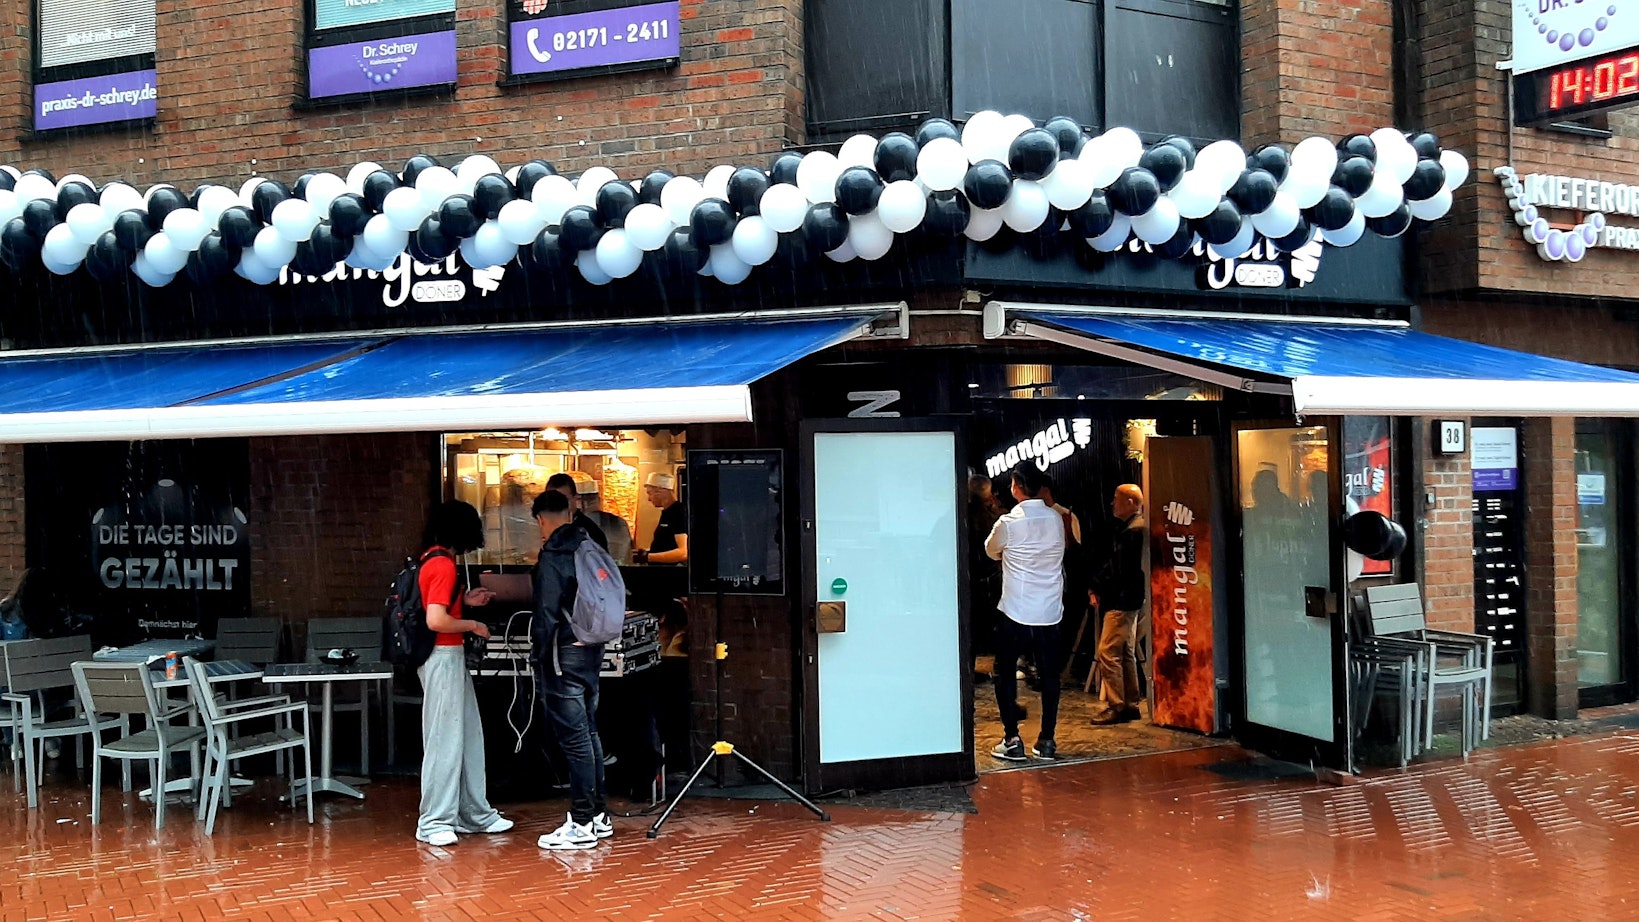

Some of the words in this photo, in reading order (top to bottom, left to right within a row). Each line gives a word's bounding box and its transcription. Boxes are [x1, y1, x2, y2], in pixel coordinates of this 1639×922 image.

[362, 45, 378, 58] Dr.
[379, 42, 418, 56] Schrey
[553, 27, 607, 51] 02171
[627, 19, 669, 43] 2411
[41, 82, 157, 116] praxis-dr-schrey.de
[1549, 55, 1639, 110] 14:02
[1605, 225, 1639, 249] PRA
[986, 418, 1069, 478] mangal
[1446, 428, 1459, 444] 38
[99, 525, 129, 545] DIE
[134, 525, 185, 545] TAGE
[190, 525, 238, 546] SIND
[100, 550, 238, 590] GEZÄHLT
[1166, 532, 1199, 656] mangal
